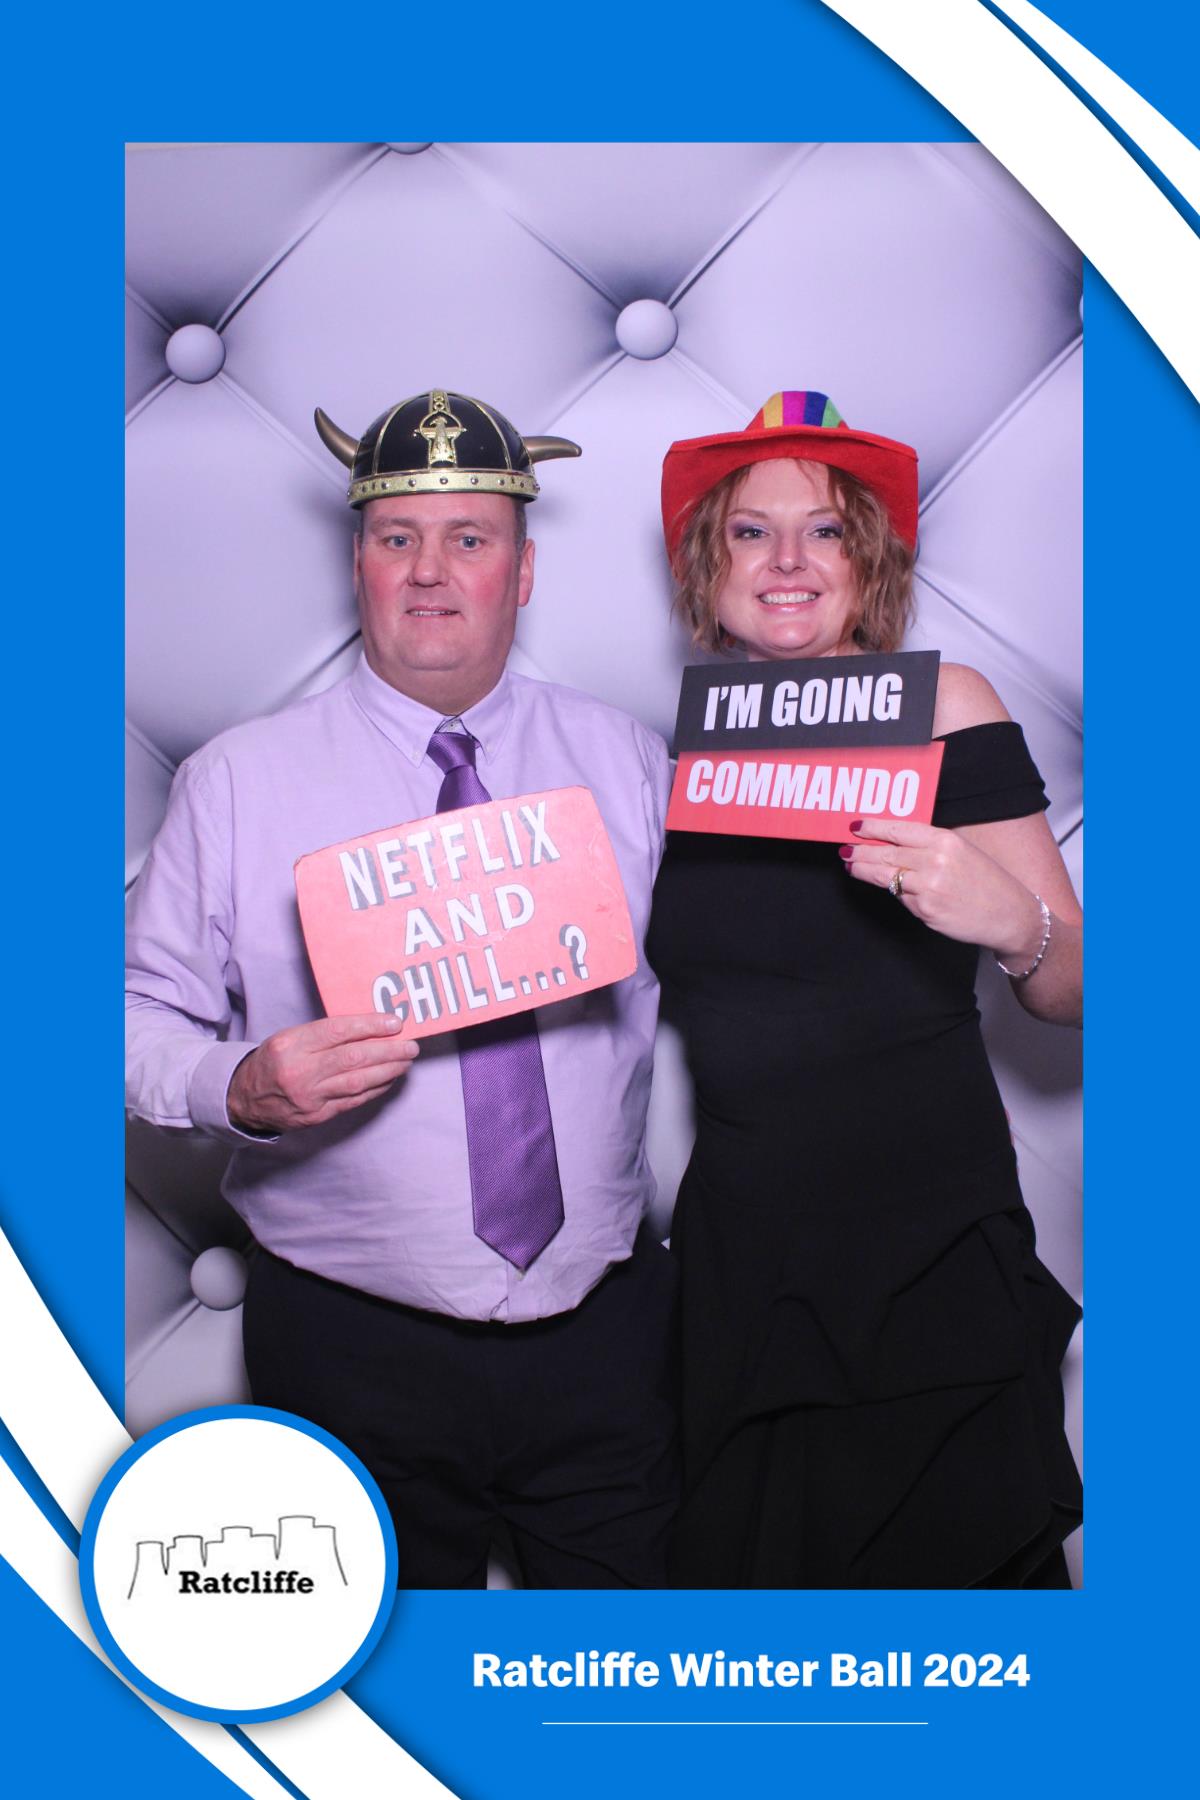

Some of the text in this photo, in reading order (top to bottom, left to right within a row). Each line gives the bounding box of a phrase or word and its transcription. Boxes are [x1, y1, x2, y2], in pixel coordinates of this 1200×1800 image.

[704, 673, 903, 730] I'M GOING
[686, 759, 920, 817] COMMANDO
[339, 801, 560, 911] NETFLIX
[404, 883, 535, 955] AND
[372, 924, 589, 1024] CHILL...?
